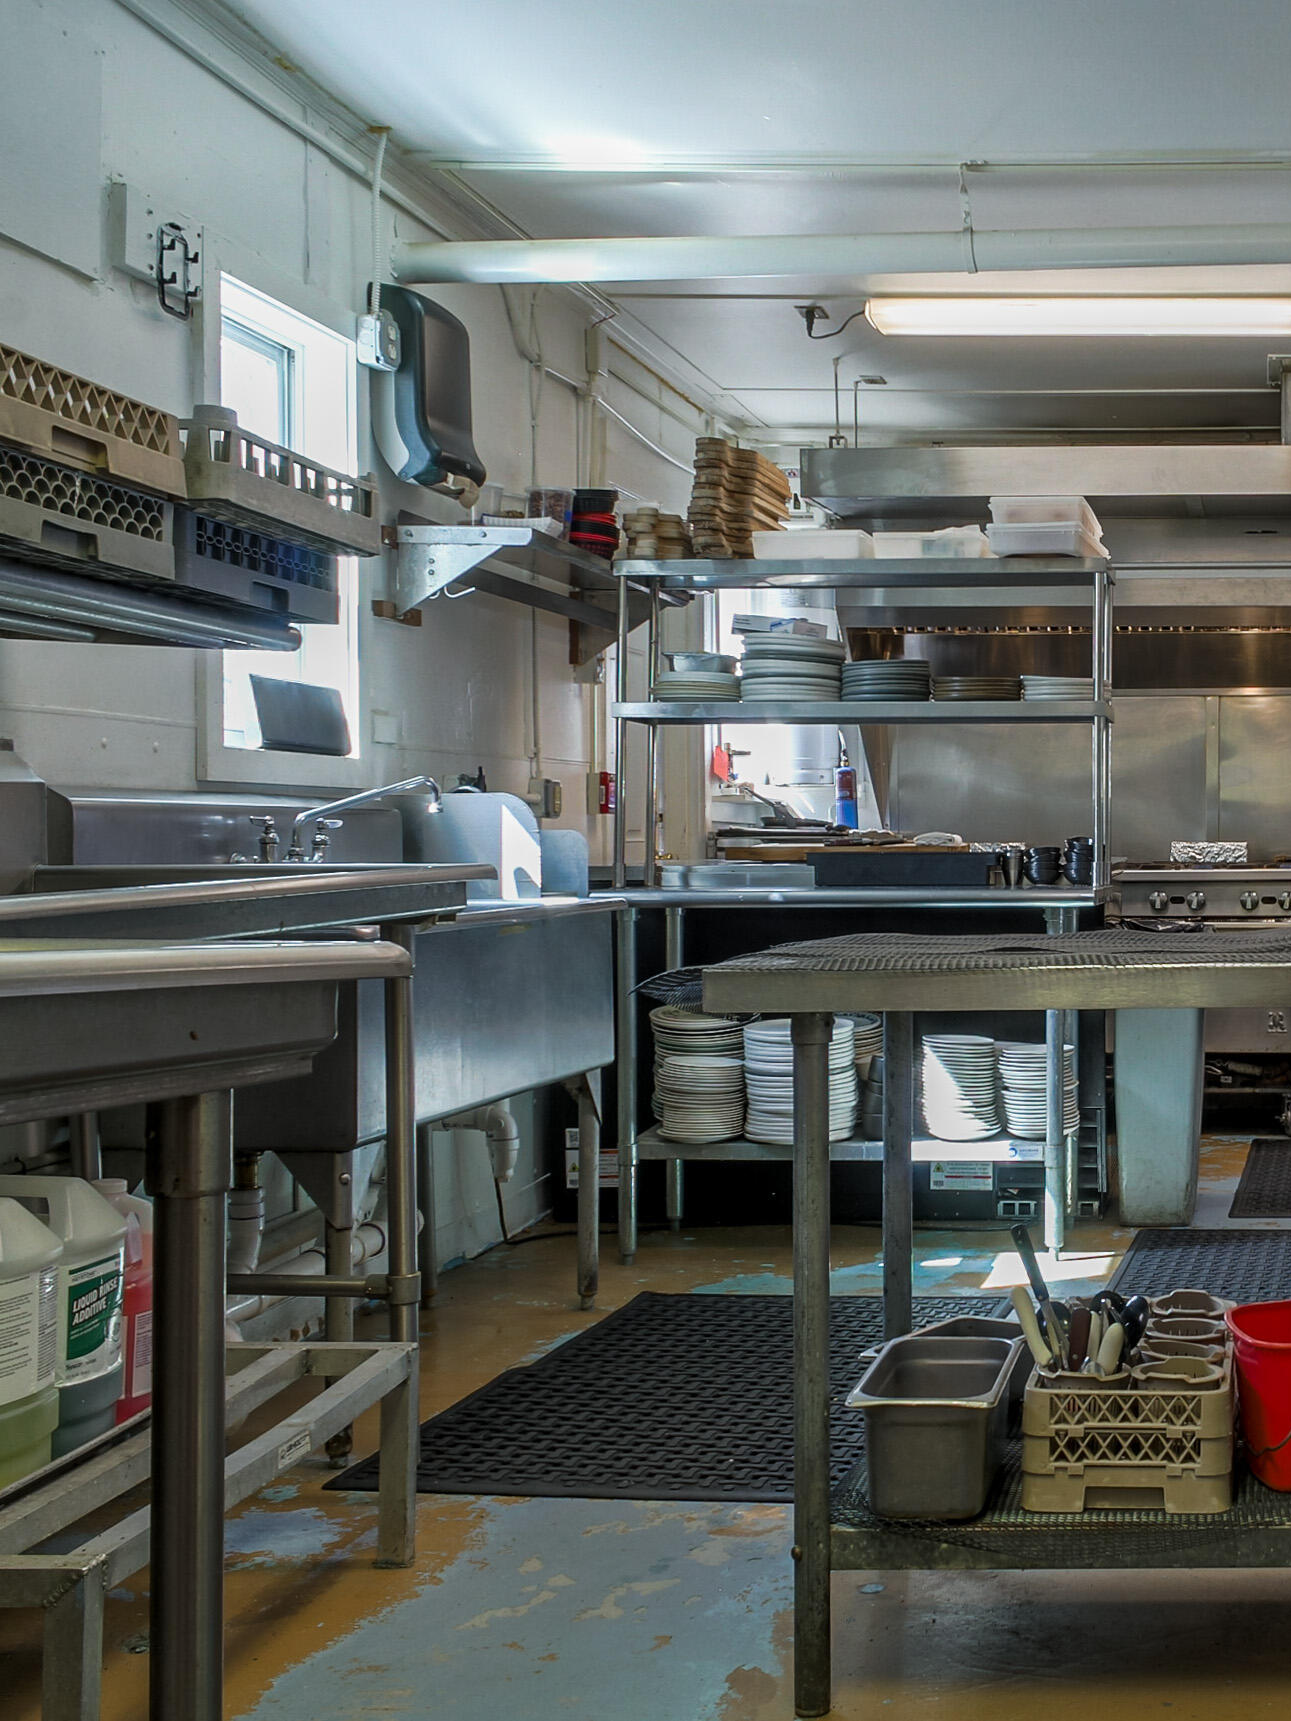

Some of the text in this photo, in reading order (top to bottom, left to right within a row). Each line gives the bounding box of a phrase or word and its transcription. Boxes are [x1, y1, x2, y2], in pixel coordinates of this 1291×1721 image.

[73, 1289, 98, 1312] LIQUID
[100, 1276, 118, 1297] RINSE
[72, 1297, 107, 1326] ADDITIVE
